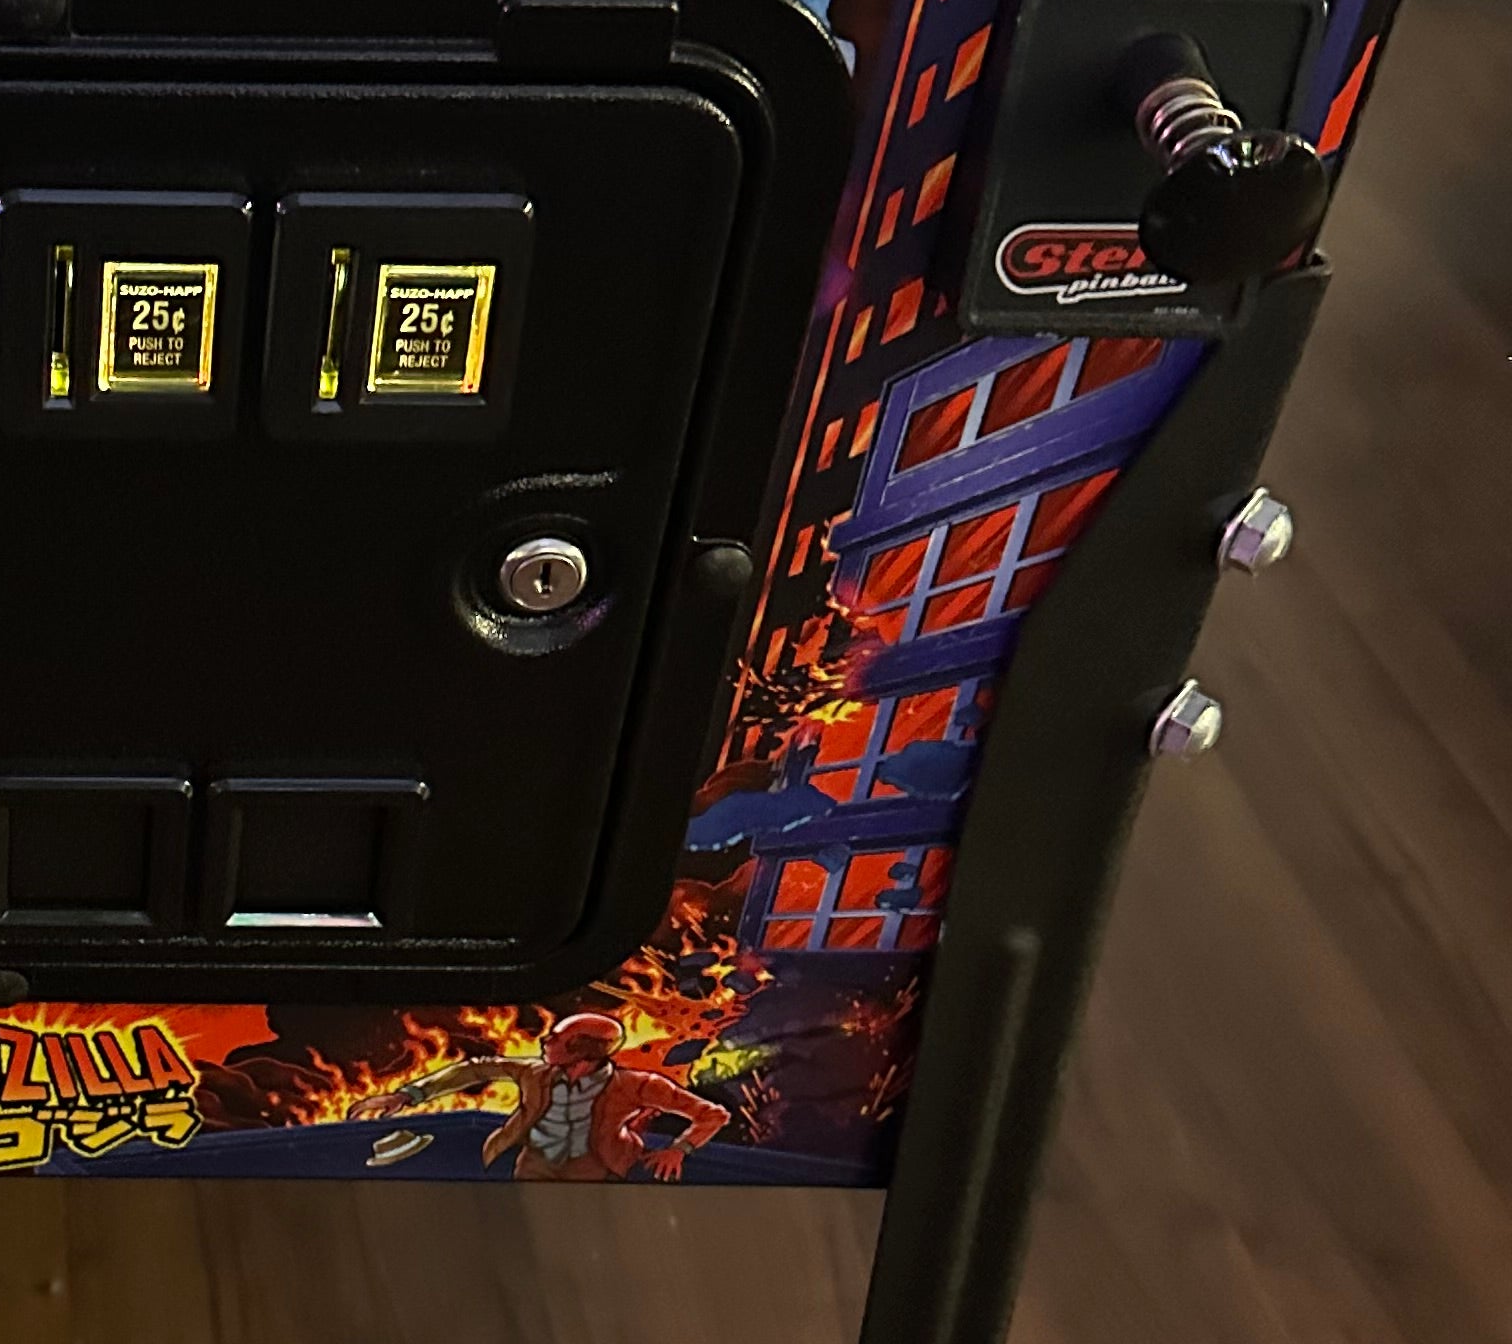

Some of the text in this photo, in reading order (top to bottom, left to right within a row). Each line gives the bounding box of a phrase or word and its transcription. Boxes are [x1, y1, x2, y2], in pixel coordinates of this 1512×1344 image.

[1024, 241, 1146, 275] Ste
[119, 284, 203, 297] SUZO-HAPP
[1067, 272, 1178, 295] pinbal
[390, 287, 475, 299] SUZO-HAPP
[132, 300, 186, 335] 25¢
[399, 302, 454, 338] 25¢
[128, 336, 184, 351] PUSH TO
[395, 339, 451, 353] PUSH TO
[133, 352, 182, 366] REJECT
[399, 354, 449, 368] REJECT
